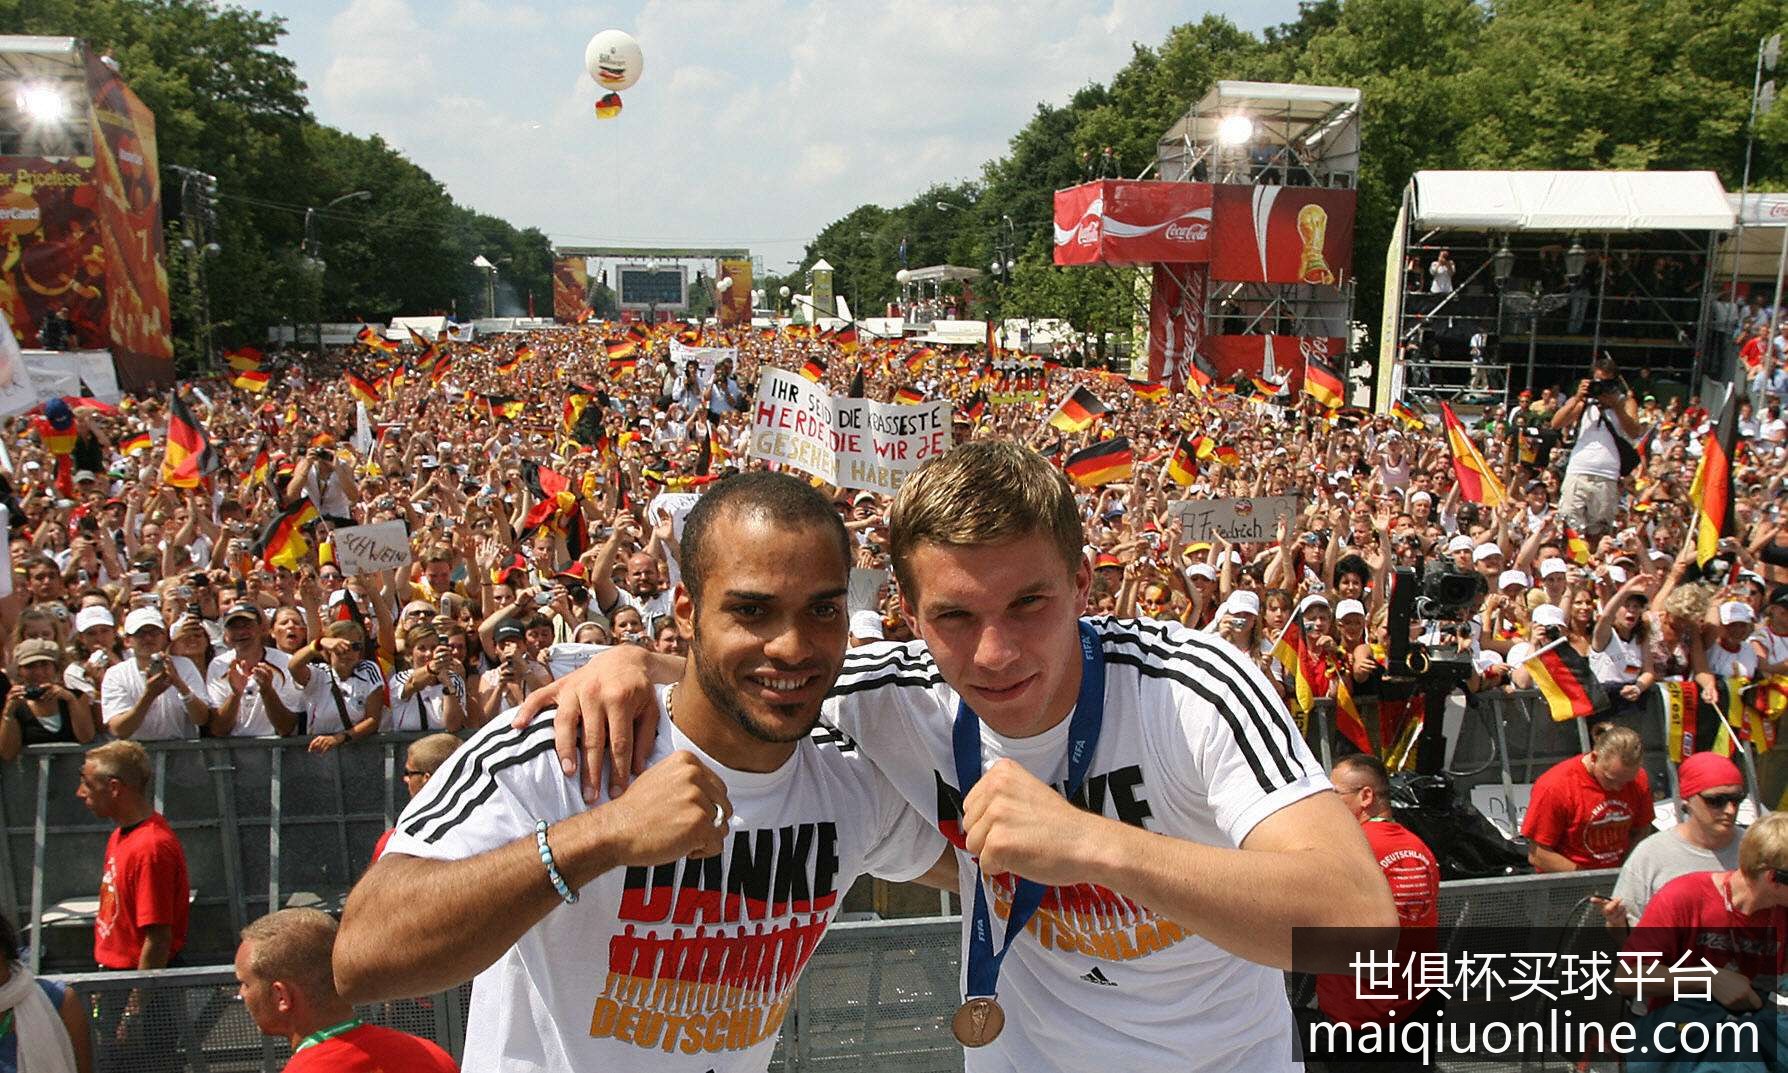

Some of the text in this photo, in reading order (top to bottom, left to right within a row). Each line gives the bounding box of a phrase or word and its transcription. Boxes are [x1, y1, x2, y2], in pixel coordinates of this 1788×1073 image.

[771, 378, 942, 436] IHR SEID DIE KRASSESTE
[756, 431, 840, 482] GESEHEN
[829, 429, 862, 453] DIE
[873, 438, 908, 461] WIR
[916, 432, 945, 460] JE
[1198, 509, 1263, 541] Friedrich
[1082, 635, 1094, 660] FIFA
[1072, 740, 1086, 764] FIFA
[617, 822, 839, 926] DANKE
[977, 918, 985, 942] FIFA
